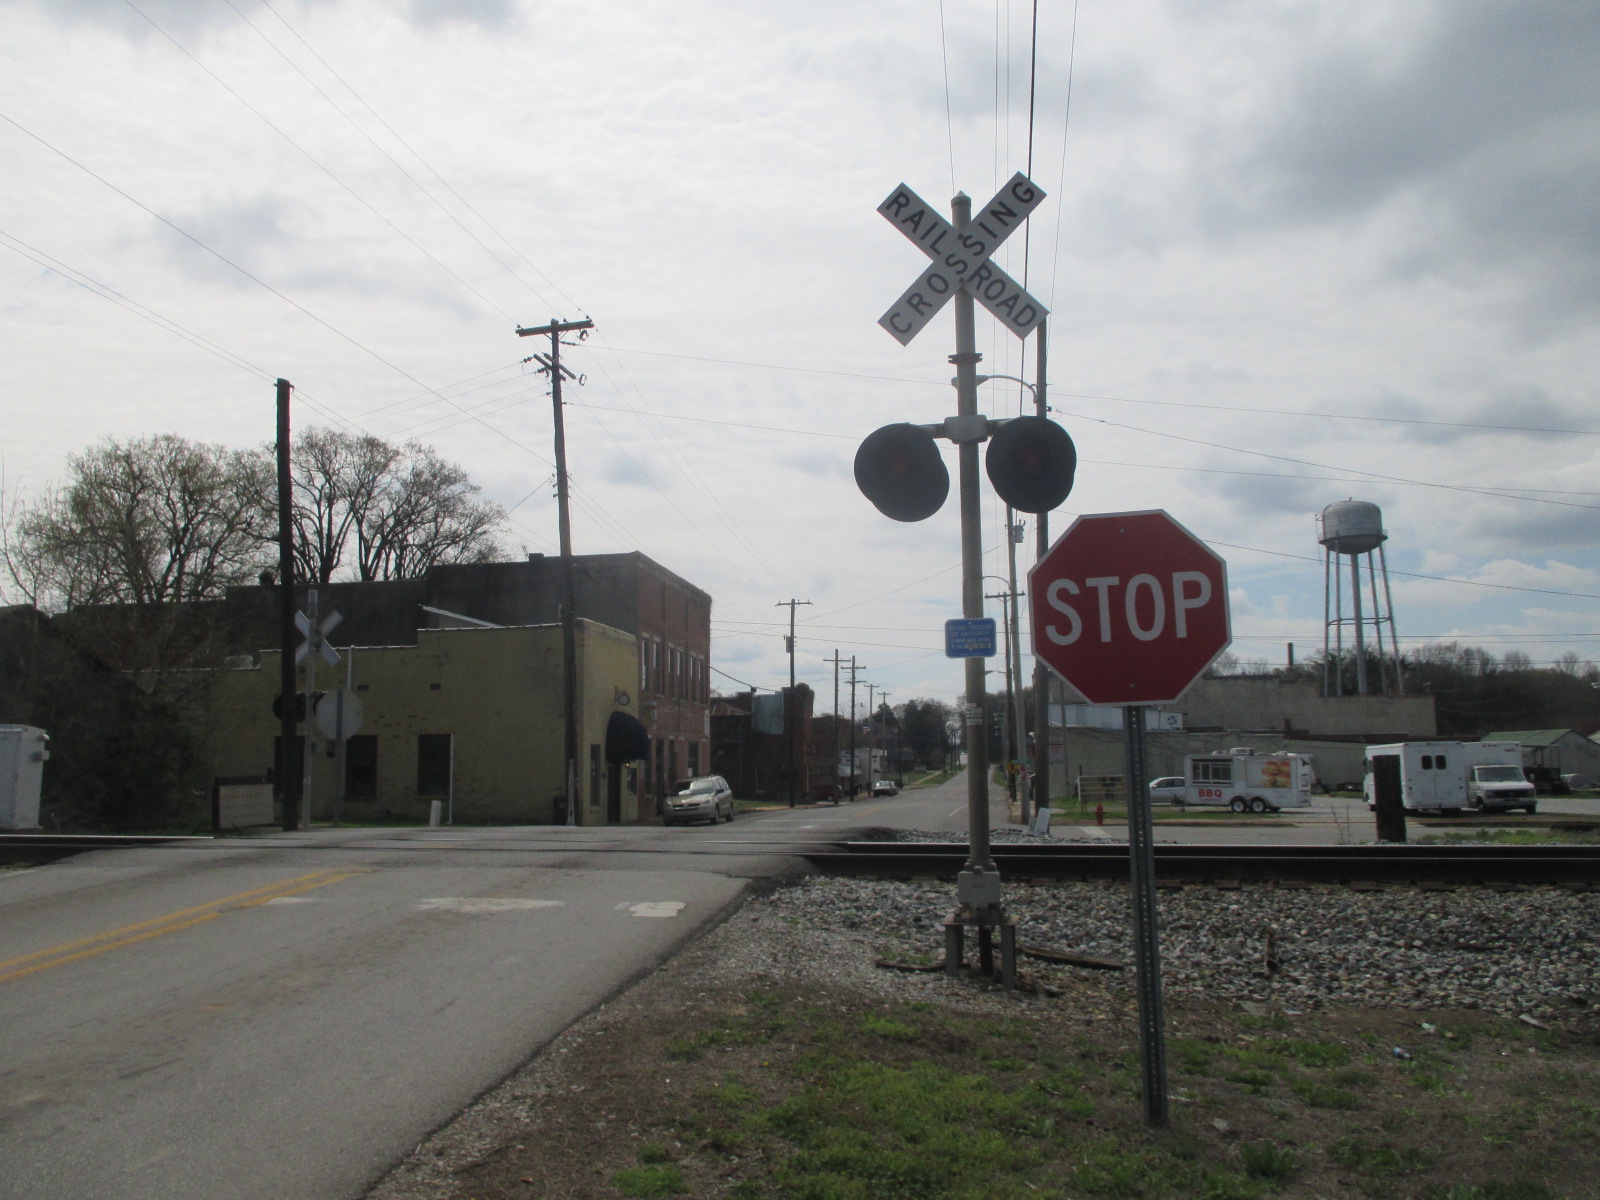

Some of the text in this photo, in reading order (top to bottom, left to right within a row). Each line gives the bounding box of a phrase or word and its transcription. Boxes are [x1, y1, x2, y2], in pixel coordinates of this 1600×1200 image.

[889, 181, 1035, 334] CROSSING
[1045, 570, 1212, 646] STOP
[1198, 788, 1223, 798] BBQ
